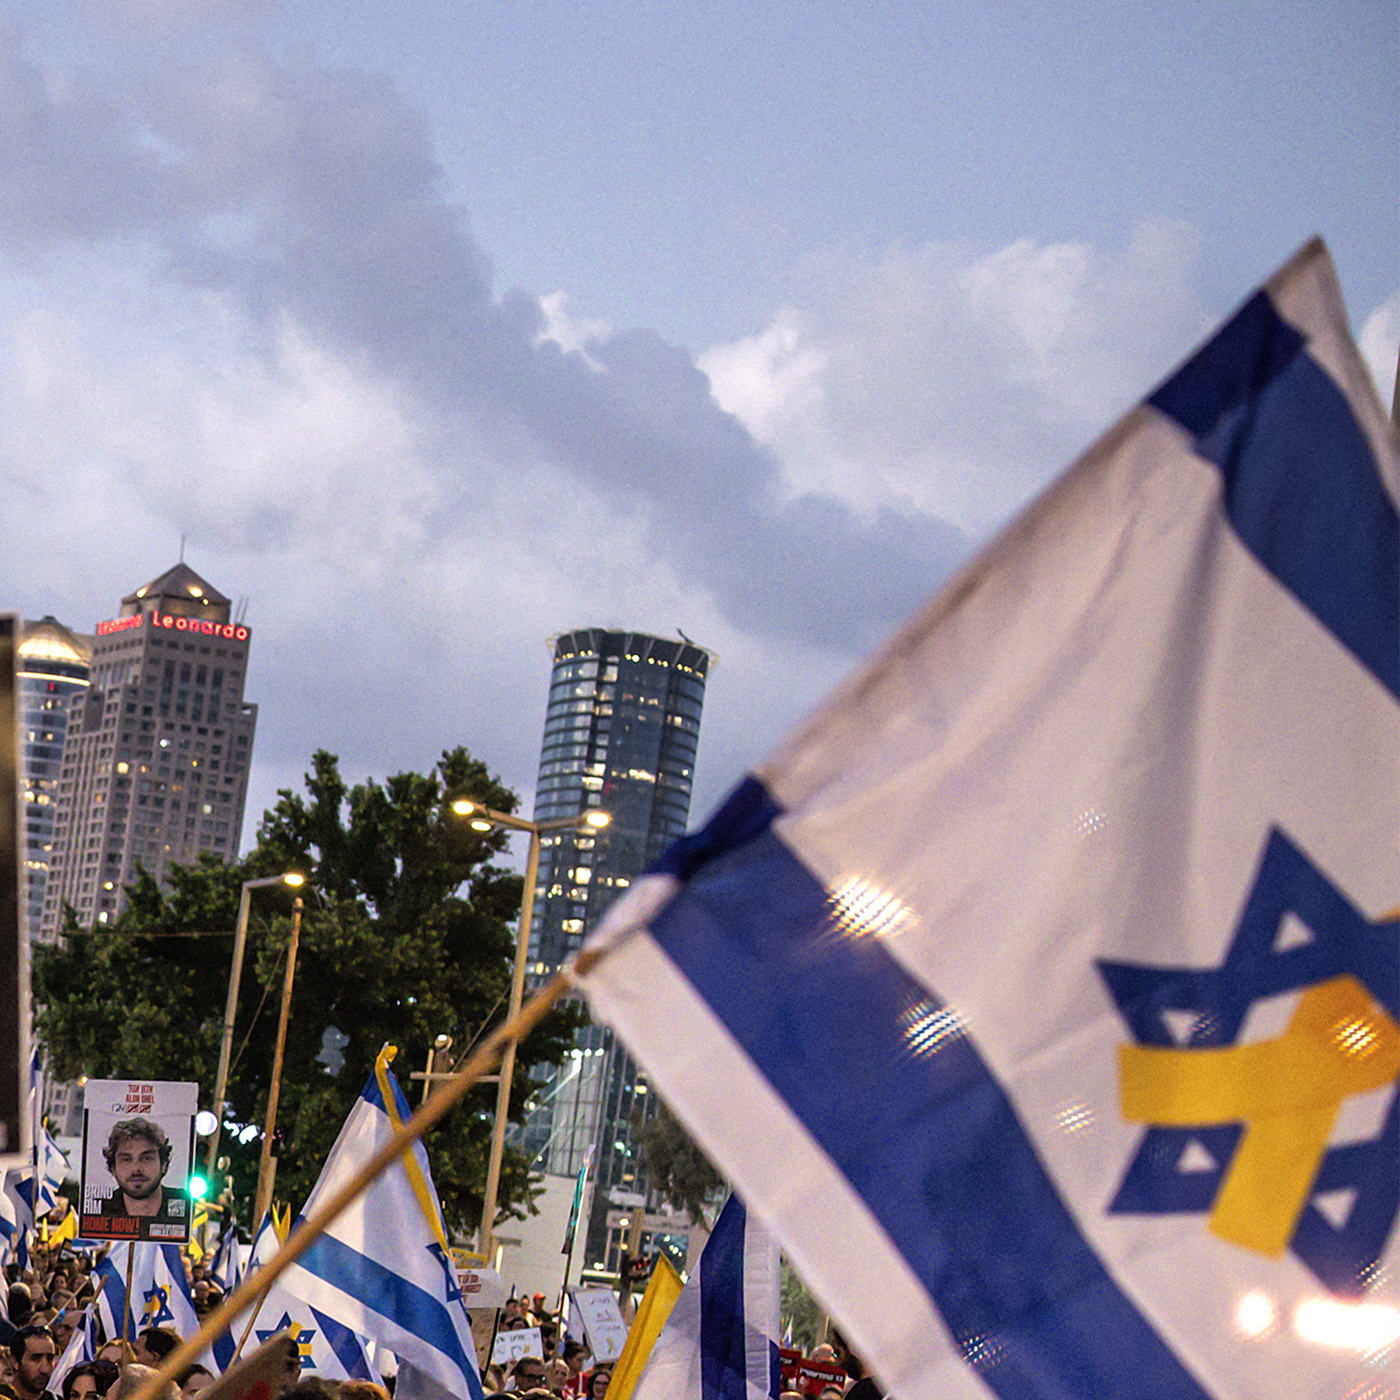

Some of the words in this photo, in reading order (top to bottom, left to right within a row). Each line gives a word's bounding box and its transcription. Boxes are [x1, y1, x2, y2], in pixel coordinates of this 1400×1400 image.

[152, 609, 248, 641] Leonardo
[84, 1185, 113, 1199] BRING
[83, 1200, 102, 1214] HIM
[82, 1217, 109, 1231] HOME
[111, 1217, 140, 1232] NOW!
